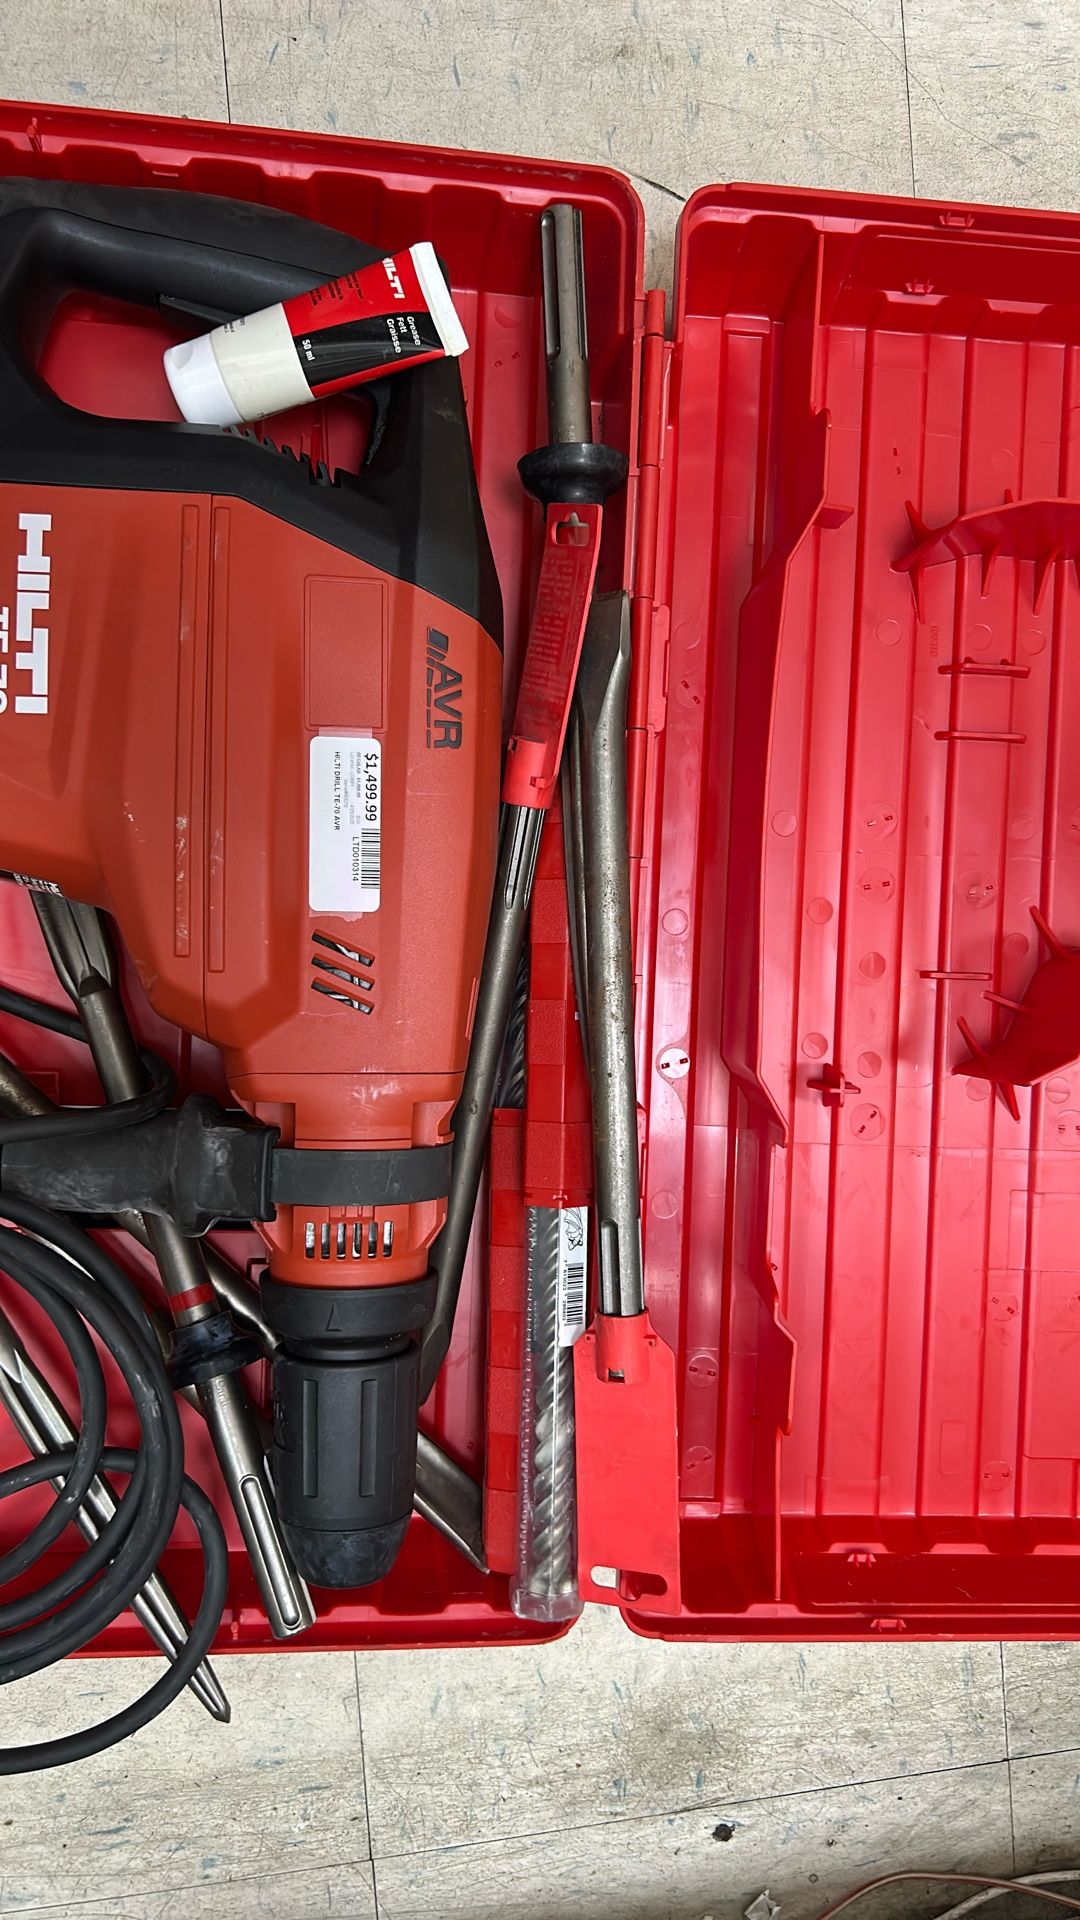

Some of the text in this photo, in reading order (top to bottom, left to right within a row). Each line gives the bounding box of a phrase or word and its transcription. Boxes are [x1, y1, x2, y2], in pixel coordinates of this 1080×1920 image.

[386, 318, 401, 354] Graisse
[396, 316, 407, 334] Fett
[406, 315, 421, 346] Grease
[302, 339, 315, 361] 50 ml
[15, 512, 52, 714] HILTI
[434, 661, 463, 750] AVR
[363, 752, 379, 822] $1,499.99
[352, 836, 360, 882] LTD010314
